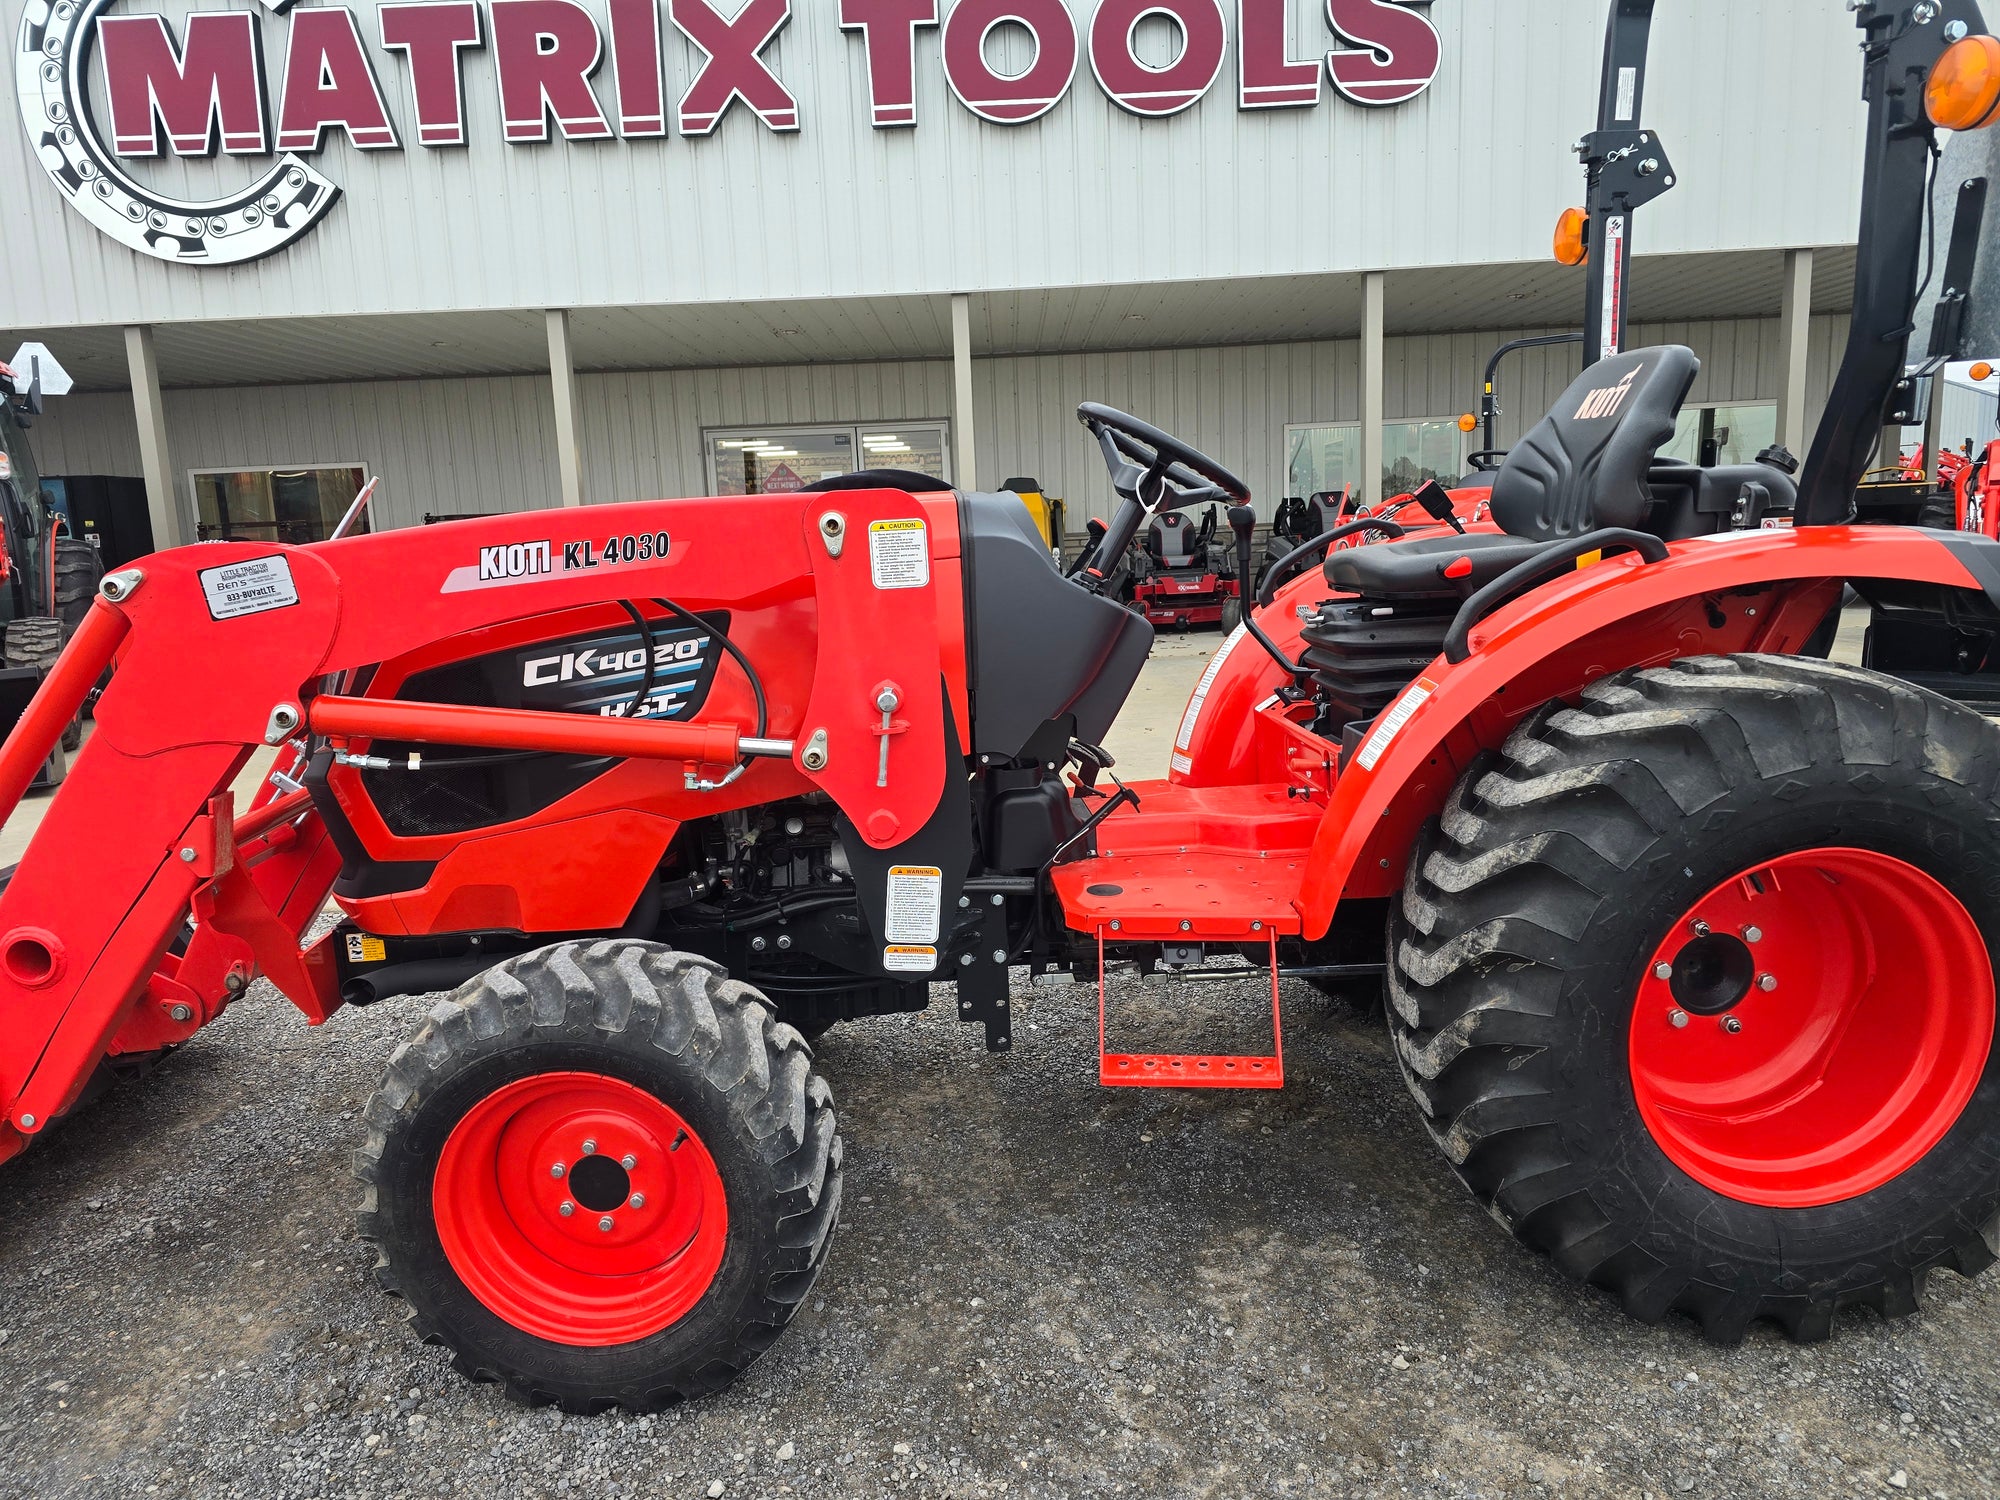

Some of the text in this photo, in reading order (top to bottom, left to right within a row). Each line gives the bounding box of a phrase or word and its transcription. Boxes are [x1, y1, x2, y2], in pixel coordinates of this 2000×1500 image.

[97, 0, 1443, 156] MATRIX TOOLS
[1573, 383, 1632, 420] KIOTI
[220, 562, 268, 578] LITTLE TRACTOR
[480, 531, 670, 581] KIOTI KL 4030
[226, 585, 276, 602] 833-BUYatLTE
[600, 692, 677, 718] HST
